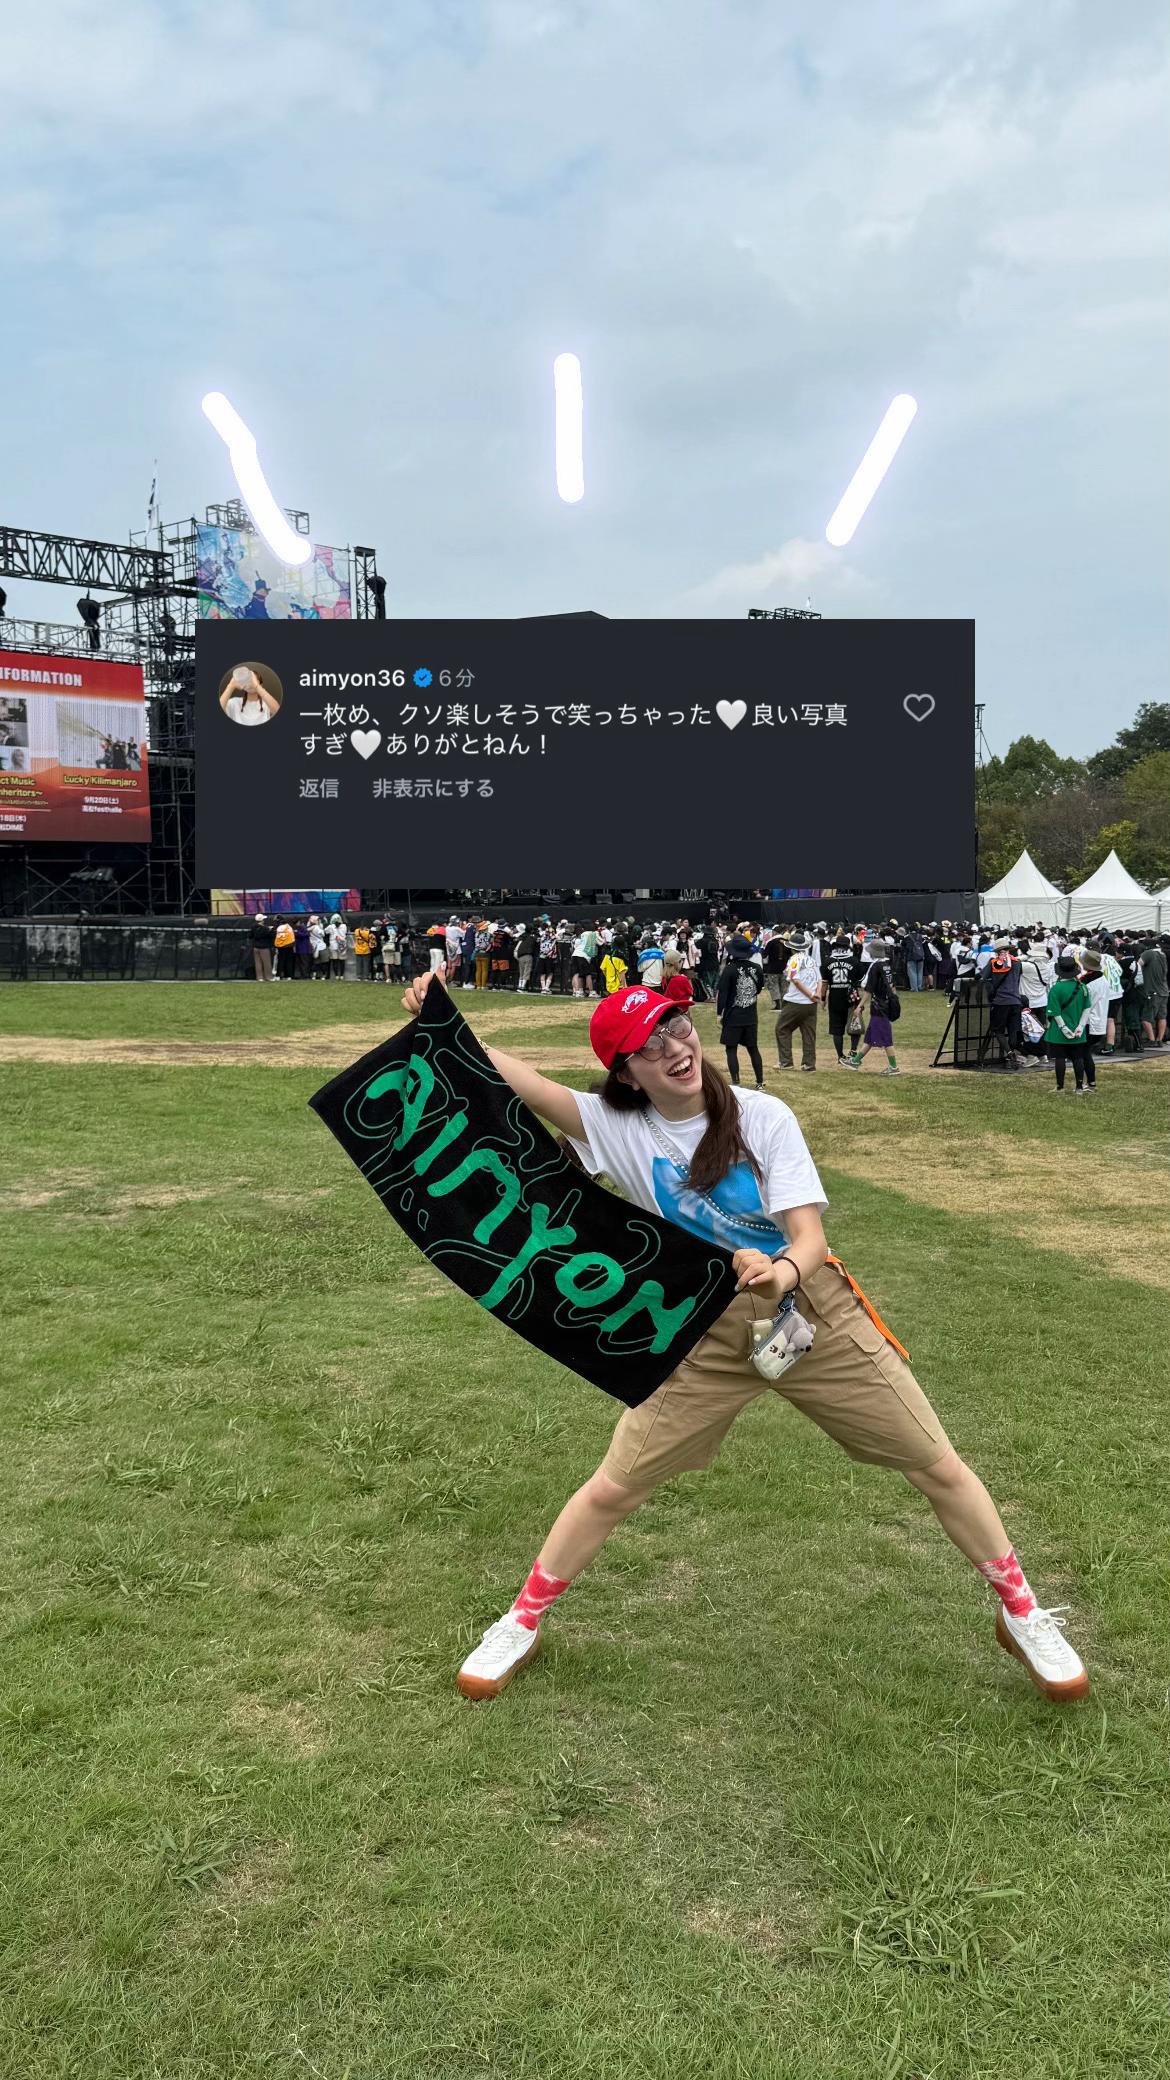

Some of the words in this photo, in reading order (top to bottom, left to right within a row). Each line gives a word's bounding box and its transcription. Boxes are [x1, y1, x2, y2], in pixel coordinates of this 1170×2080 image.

[10, 776, 36, 786] Music
[64, 775, 90, 785] Lucky
[92, 776, 138, 787] Kilimanjaro
